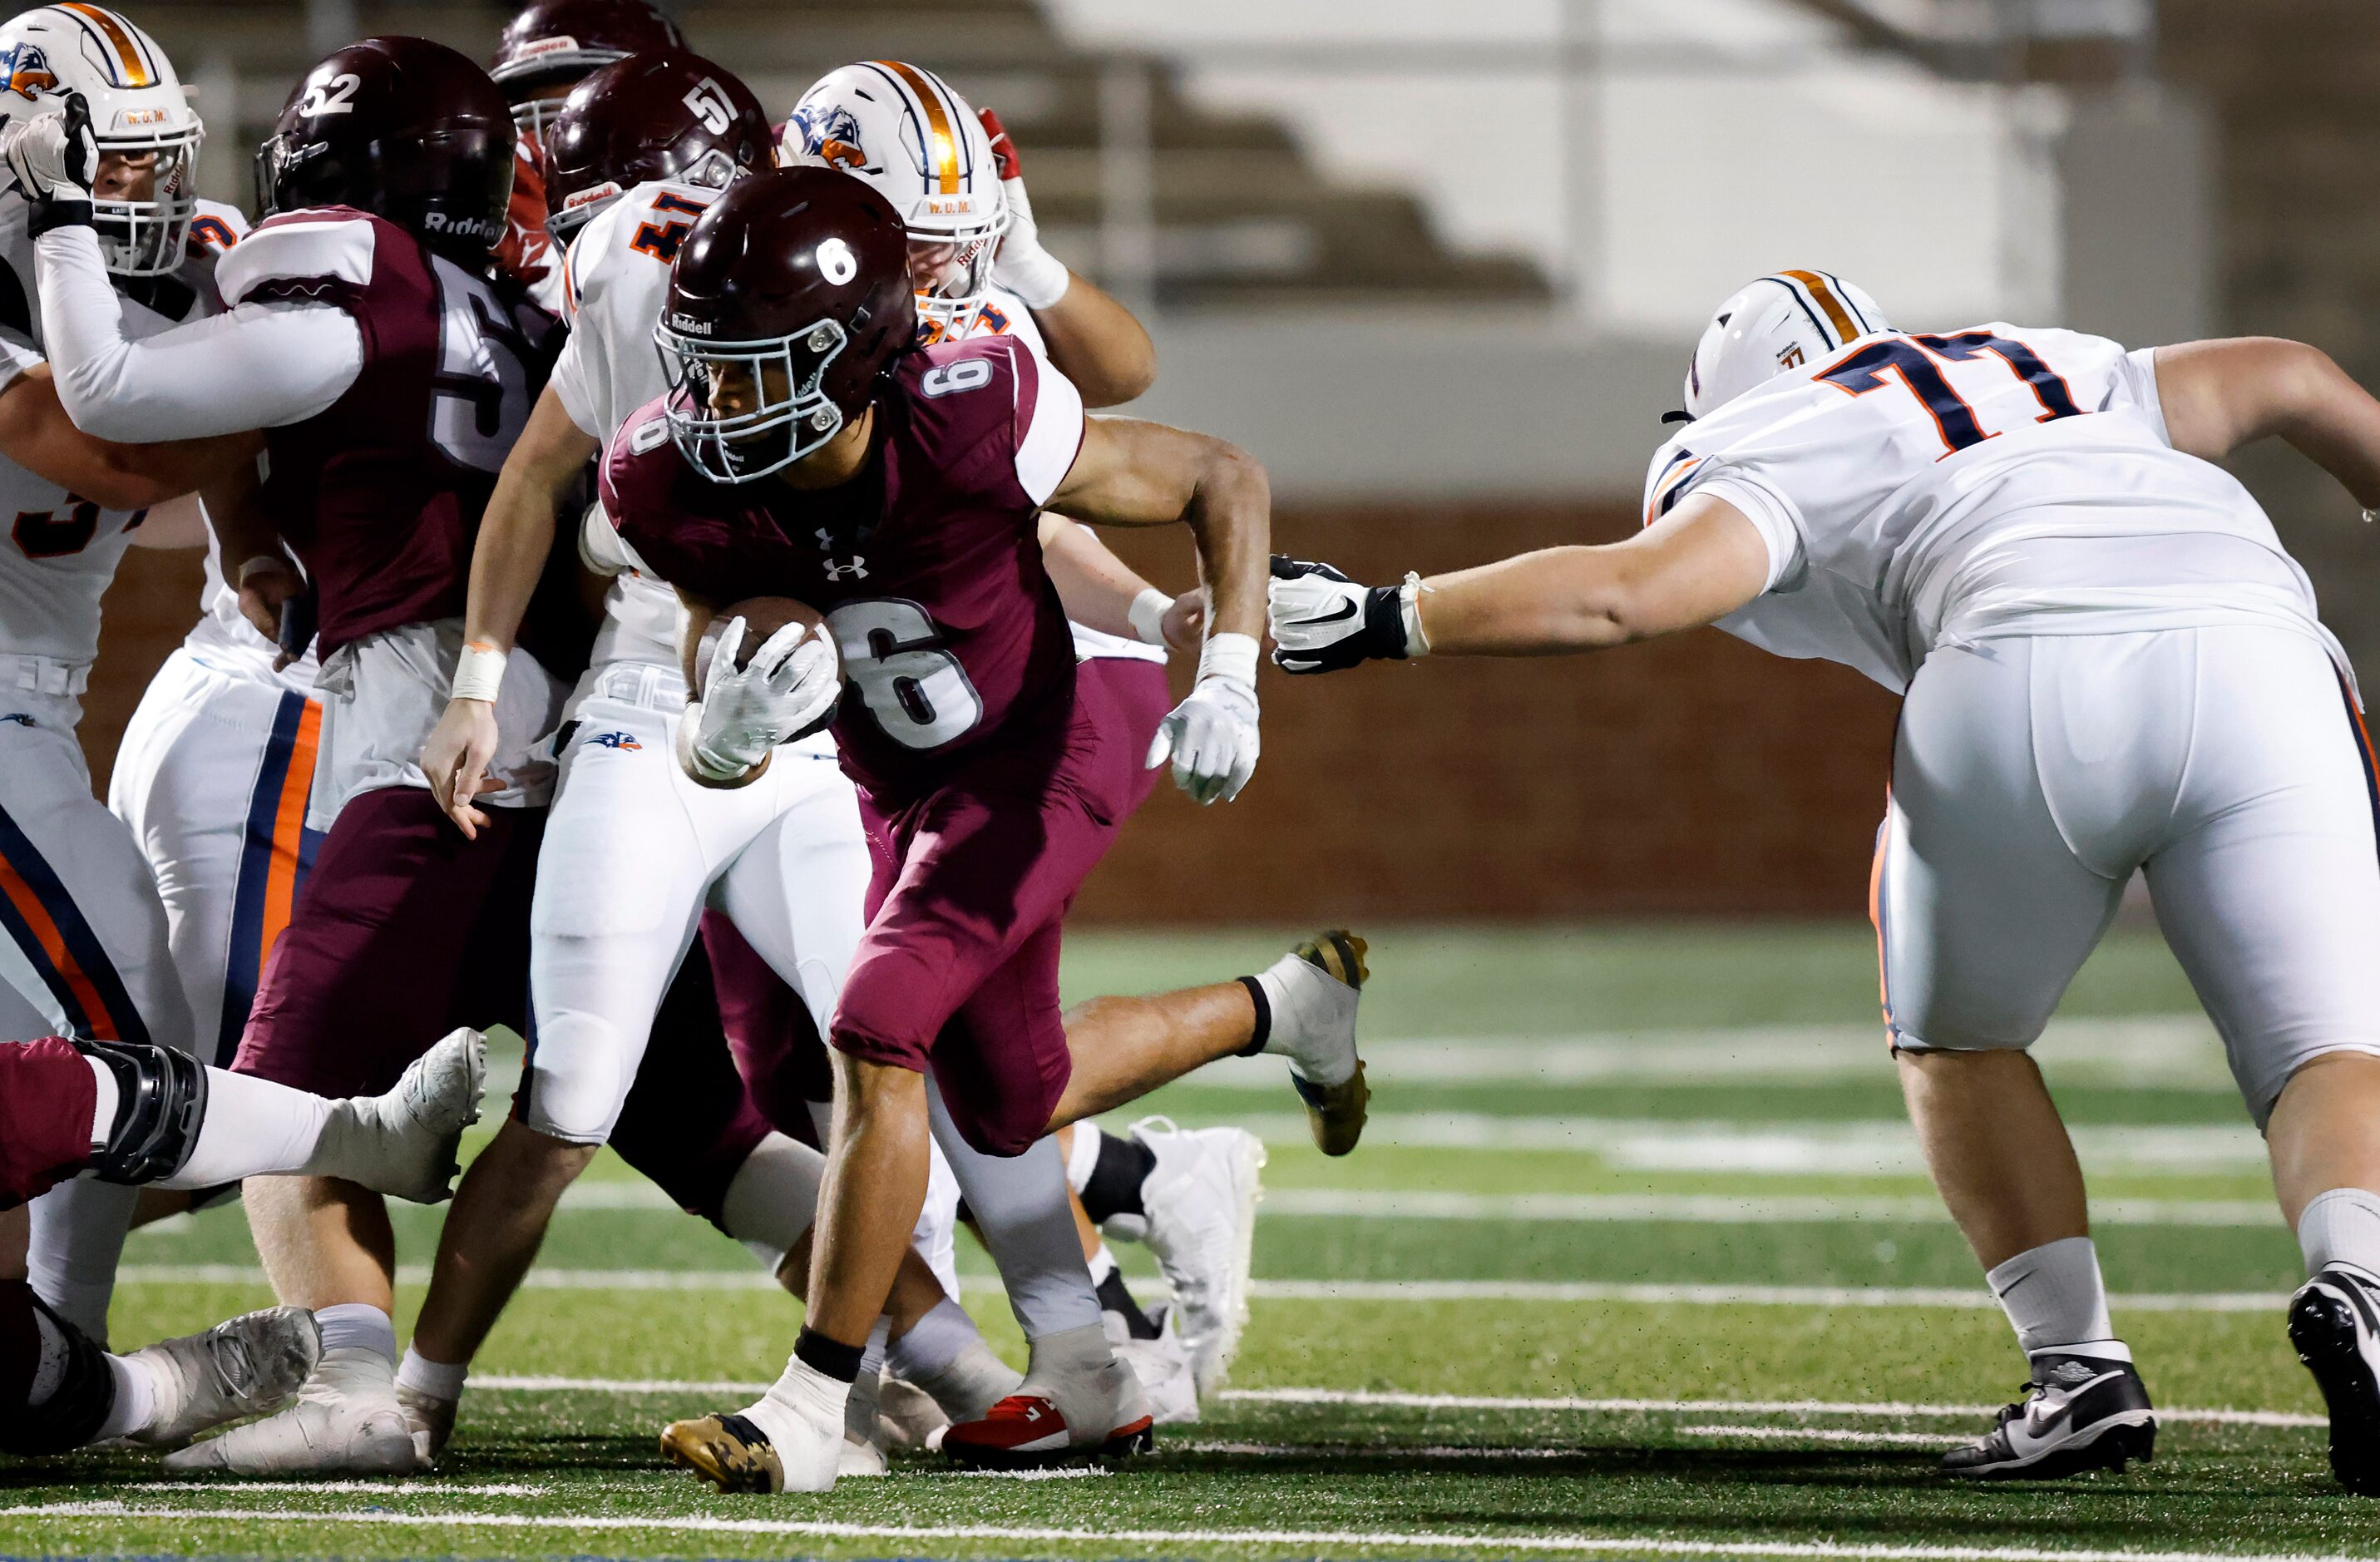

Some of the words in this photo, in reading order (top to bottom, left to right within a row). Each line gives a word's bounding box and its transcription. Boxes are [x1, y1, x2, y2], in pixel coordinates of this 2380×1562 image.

[299, 67, 361, 117] 52
[682, 77, 738, 135] 57
[816, 238, 857, 285] 6
[672, 314, 712, 334] Riddell
[920, 358, 993, 398] 6
[1780, 346, 1805, 369] 77
[1810, 330, 2092, 462] 77
[826, 596, 984, 750] 6
